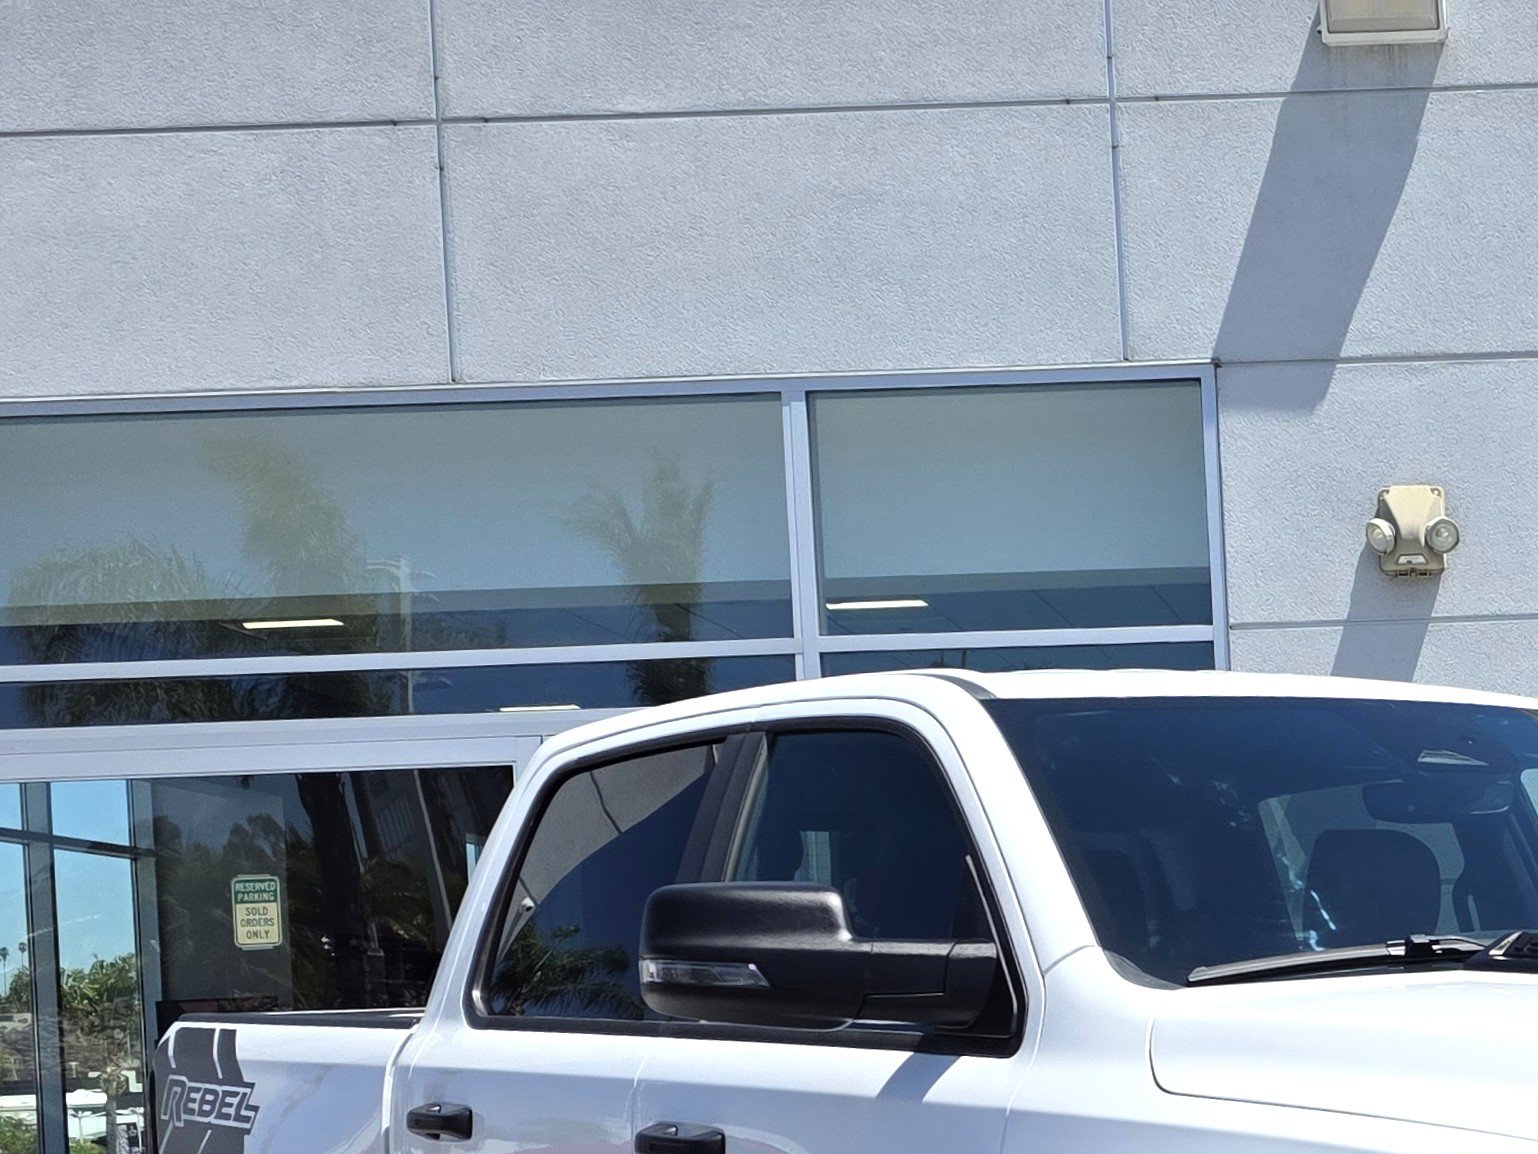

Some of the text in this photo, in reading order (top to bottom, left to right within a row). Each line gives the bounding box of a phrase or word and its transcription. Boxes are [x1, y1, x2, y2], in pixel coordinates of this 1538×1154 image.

[235, 881, 276, 892] RESERVED
[237, 891, 275, 902] PARKING
[245, 906, 269, 916] SOLD
[240, 918, 275, 928] ORDERS
[246, 929, 270, 940] ONLY
[160, 1074, 258, 1130] REBEL
